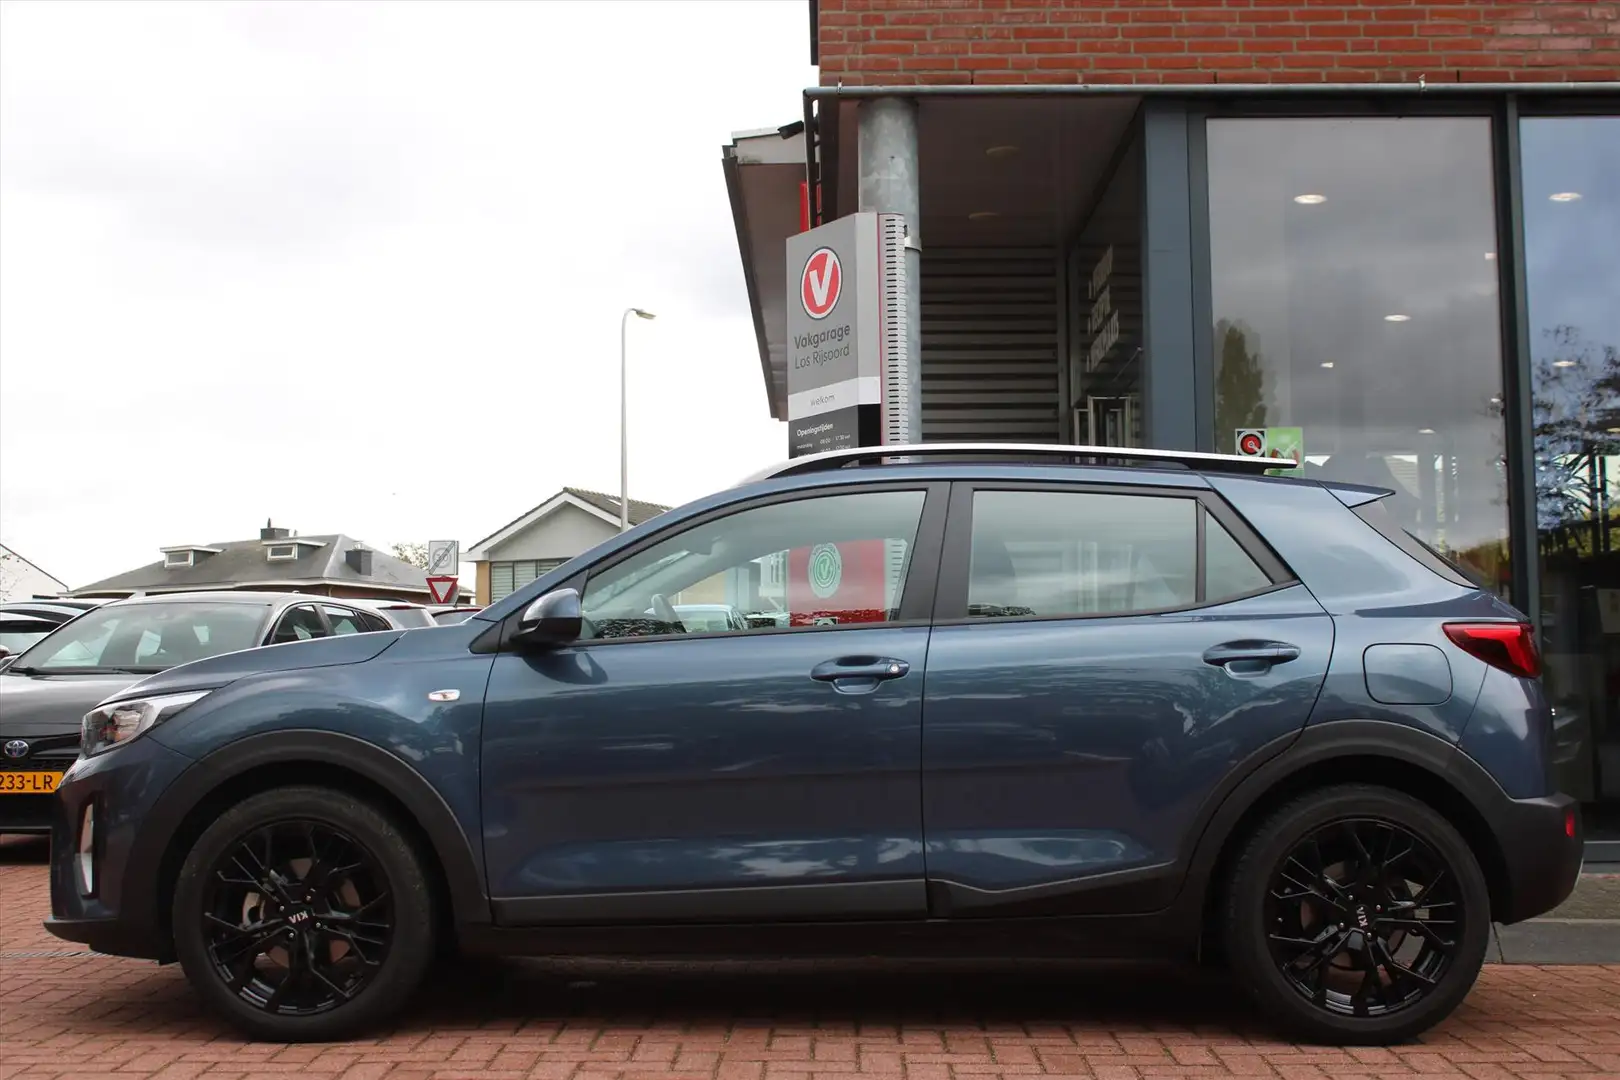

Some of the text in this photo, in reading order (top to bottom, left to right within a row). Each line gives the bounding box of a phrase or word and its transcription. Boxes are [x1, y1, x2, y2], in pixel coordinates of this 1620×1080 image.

[794, 325, 850, 350] Vakgarage
[794, 344, 850, 369] Los Rijsoord
[810, 394, 835, 408] welkom
[0, 774, 53, 790] 233-LR
[288, 910, 308, 924] KIA
[1356, 906, 1368, 926] KIA
